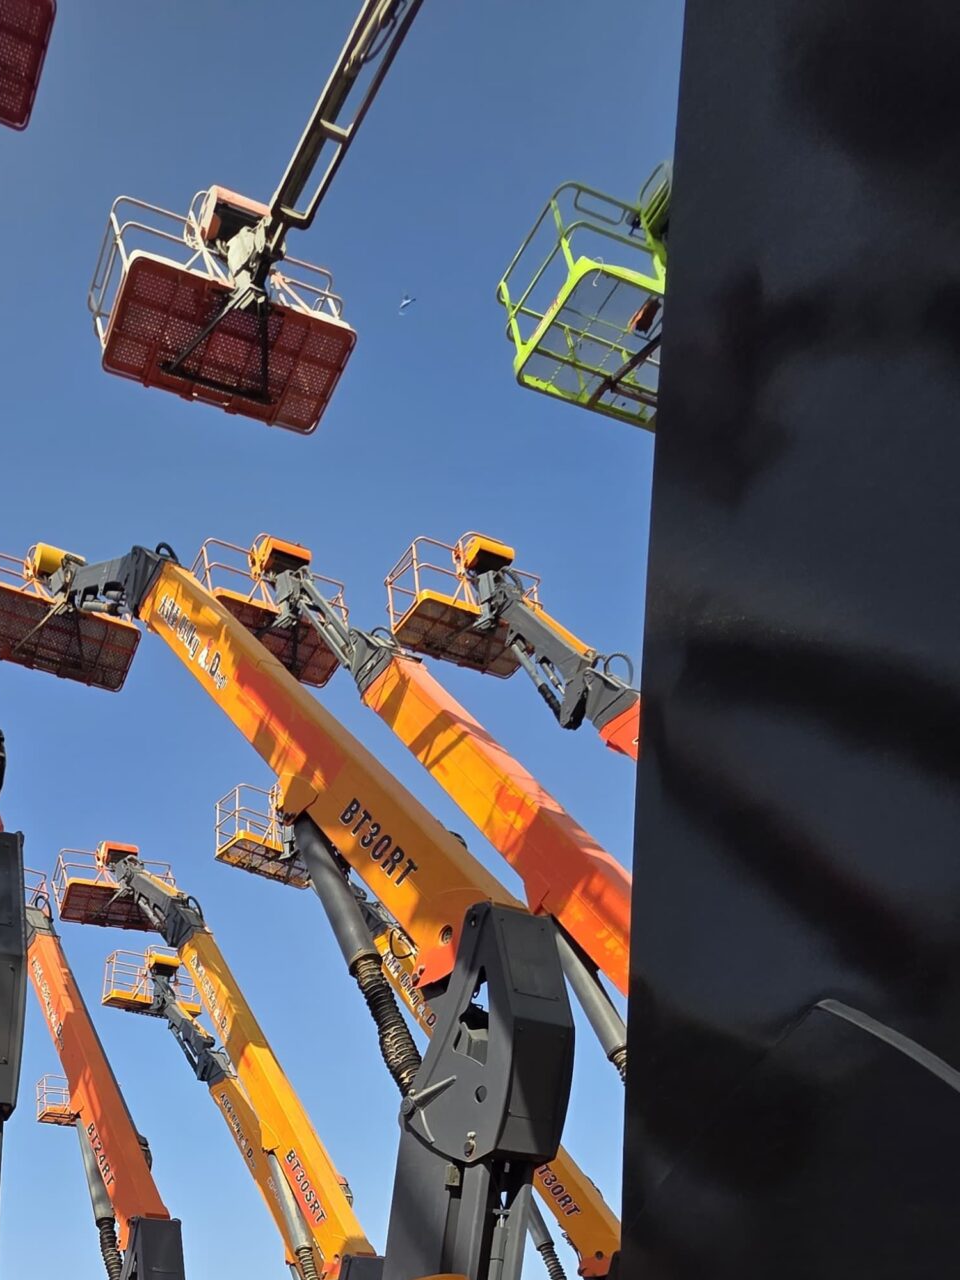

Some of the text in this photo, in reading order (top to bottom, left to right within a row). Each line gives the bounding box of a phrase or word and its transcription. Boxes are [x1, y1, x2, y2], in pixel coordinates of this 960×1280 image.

[338, 797, 419, 888] BT30RT
[86, 1121, 116, 1187] BT24RT
[284, 1148, 328, 1223] BT30SRT
[537, 1164, 581, 1216] T30RT
